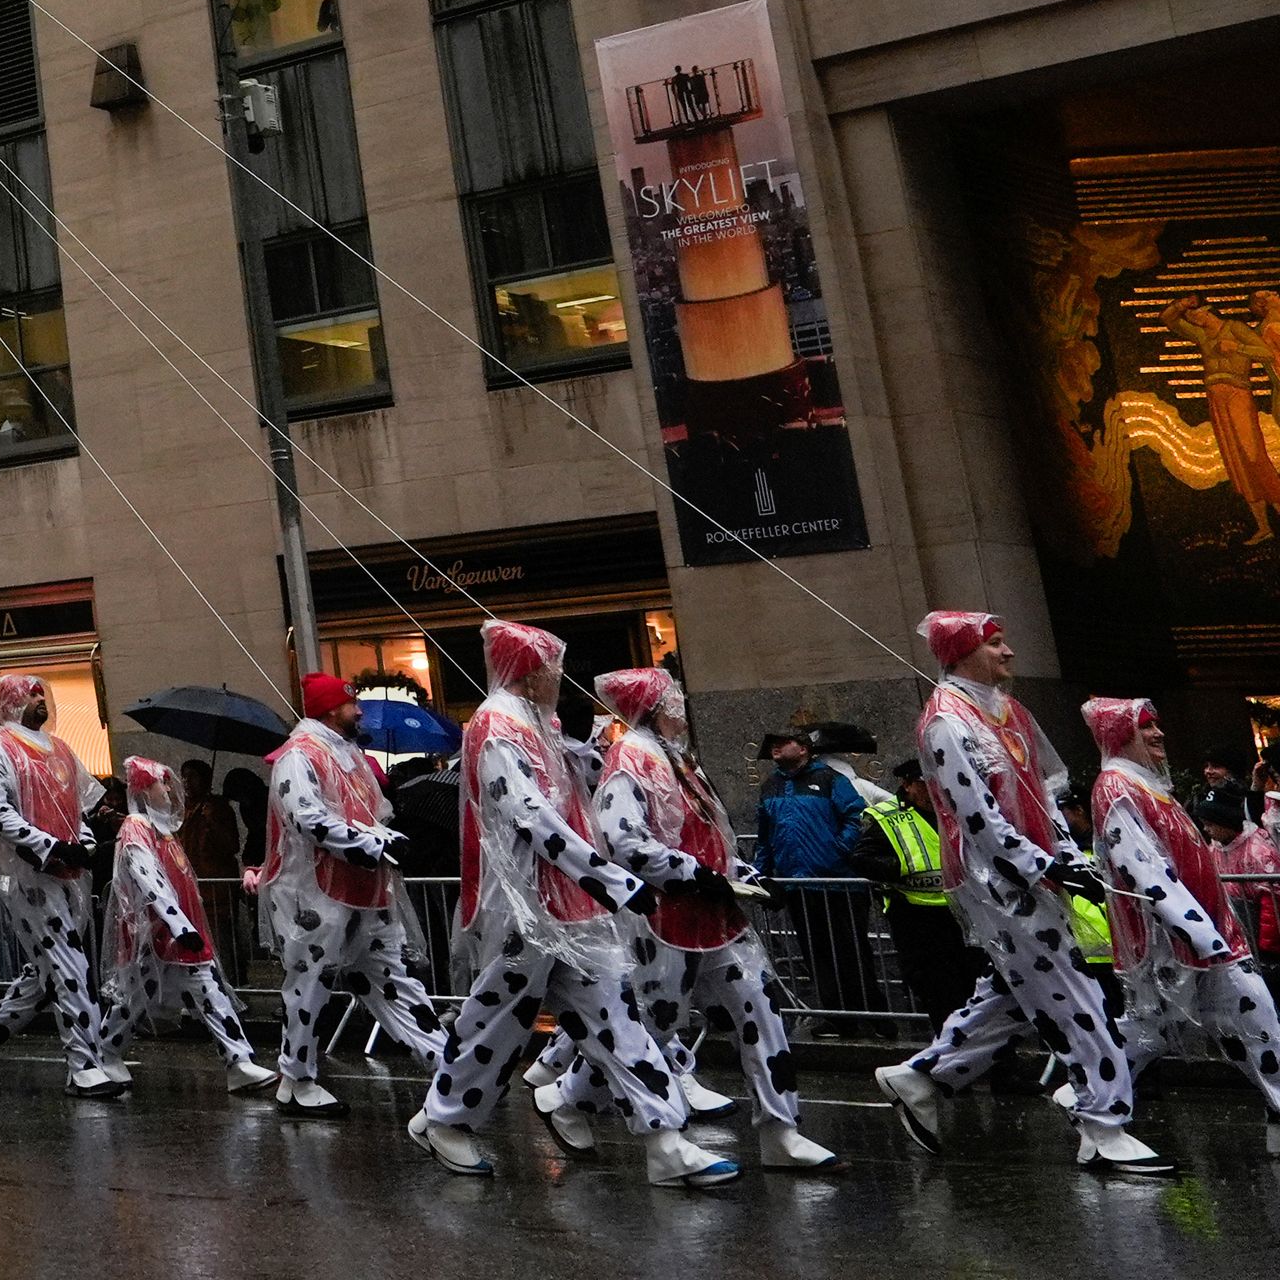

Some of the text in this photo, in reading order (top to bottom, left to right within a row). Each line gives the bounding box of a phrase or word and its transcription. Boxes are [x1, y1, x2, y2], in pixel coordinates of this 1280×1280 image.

[678, 157, 731, 174] INTRODUCING
[639, 158, 778, 219] SKYLIFT
[660, 209, 771, 242] THE GREATEST VIEW
[676, 203, 751, 226] WELCOME TO
[678, 224, 757, 249] IN THE WORLD
[706, 518, 841, 545] ROCKEFELLER CENTER
[1205, 790, 1215, 802] S
[886, 812, 914, 828] NYPD
[907, 875, 943, 888] NYPD
